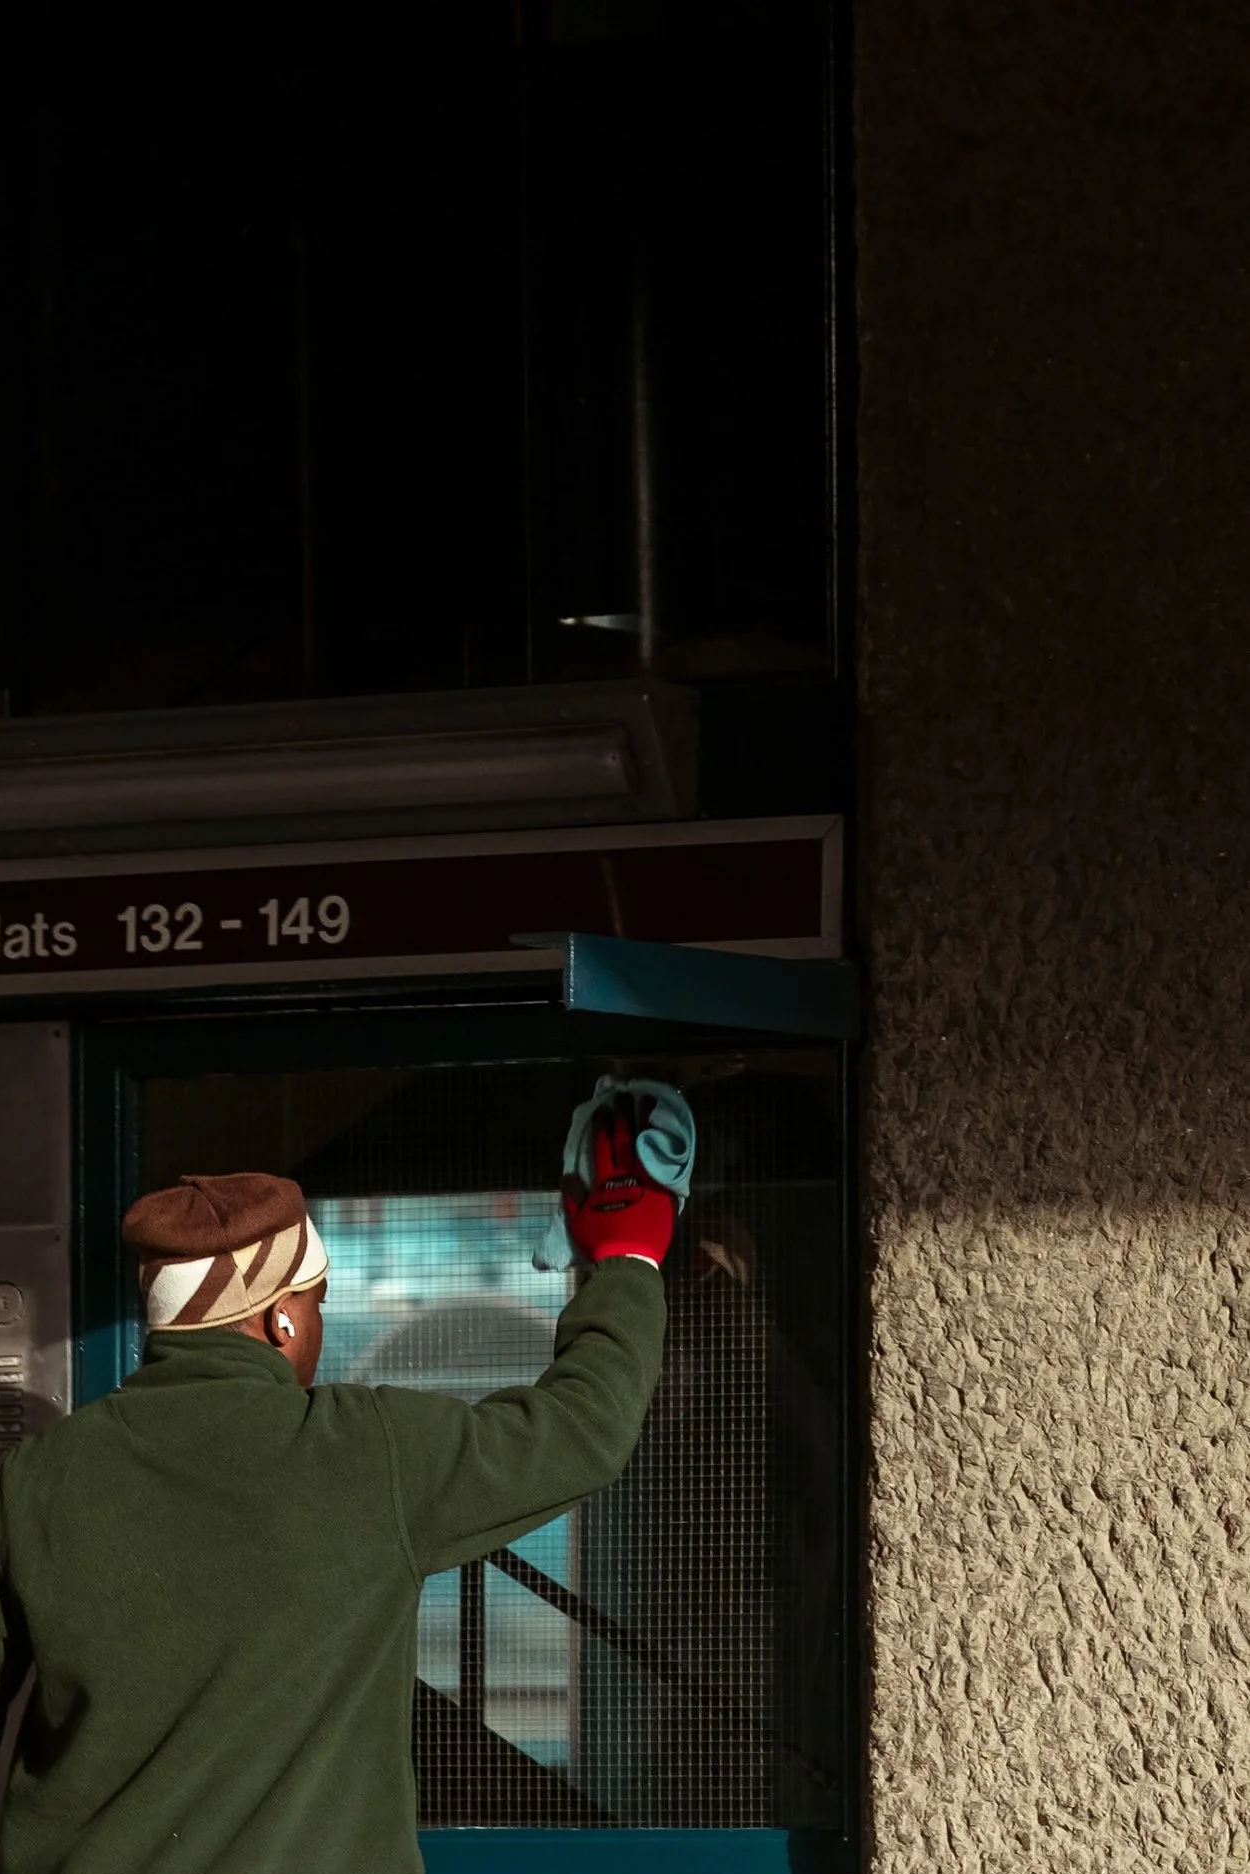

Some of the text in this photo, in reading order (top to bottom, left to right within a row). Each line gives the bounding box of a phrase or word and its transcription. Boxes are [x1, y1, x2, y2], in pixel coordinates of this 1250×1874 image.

[116, 903, 204, 954] 132
[221, 918, 242, 930] -
[258, 894, 351, 947] 149
